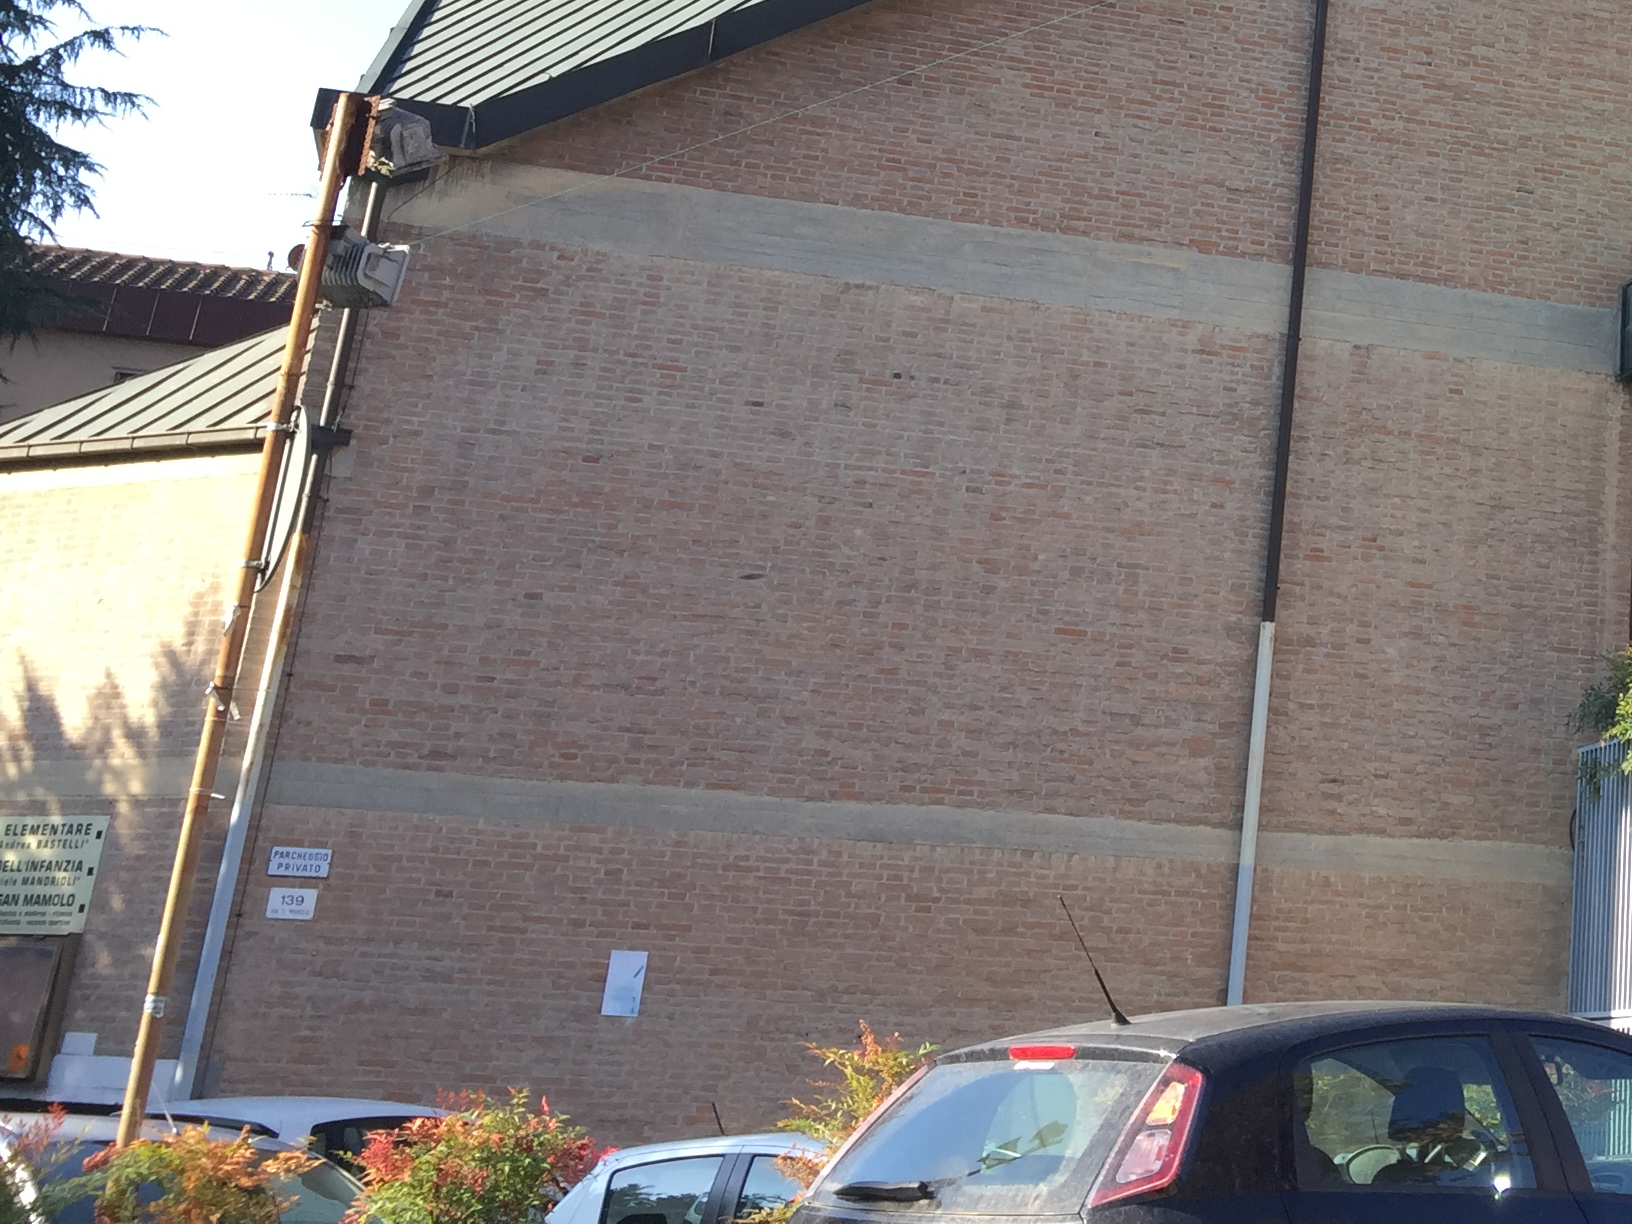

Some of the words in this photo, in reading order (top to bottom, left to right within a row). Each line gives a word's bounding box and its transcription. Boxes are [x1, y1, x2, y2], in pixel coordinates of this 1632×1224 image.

[5, 823, 93, 836] ELEMENTARE
[273, 850, 329, 862] PARCHEGGIO
[277, 862, 321, 873] PRIVATO
[22, 894, 75, 906] MAMOLO
[281, 895, 305, 906] 139
